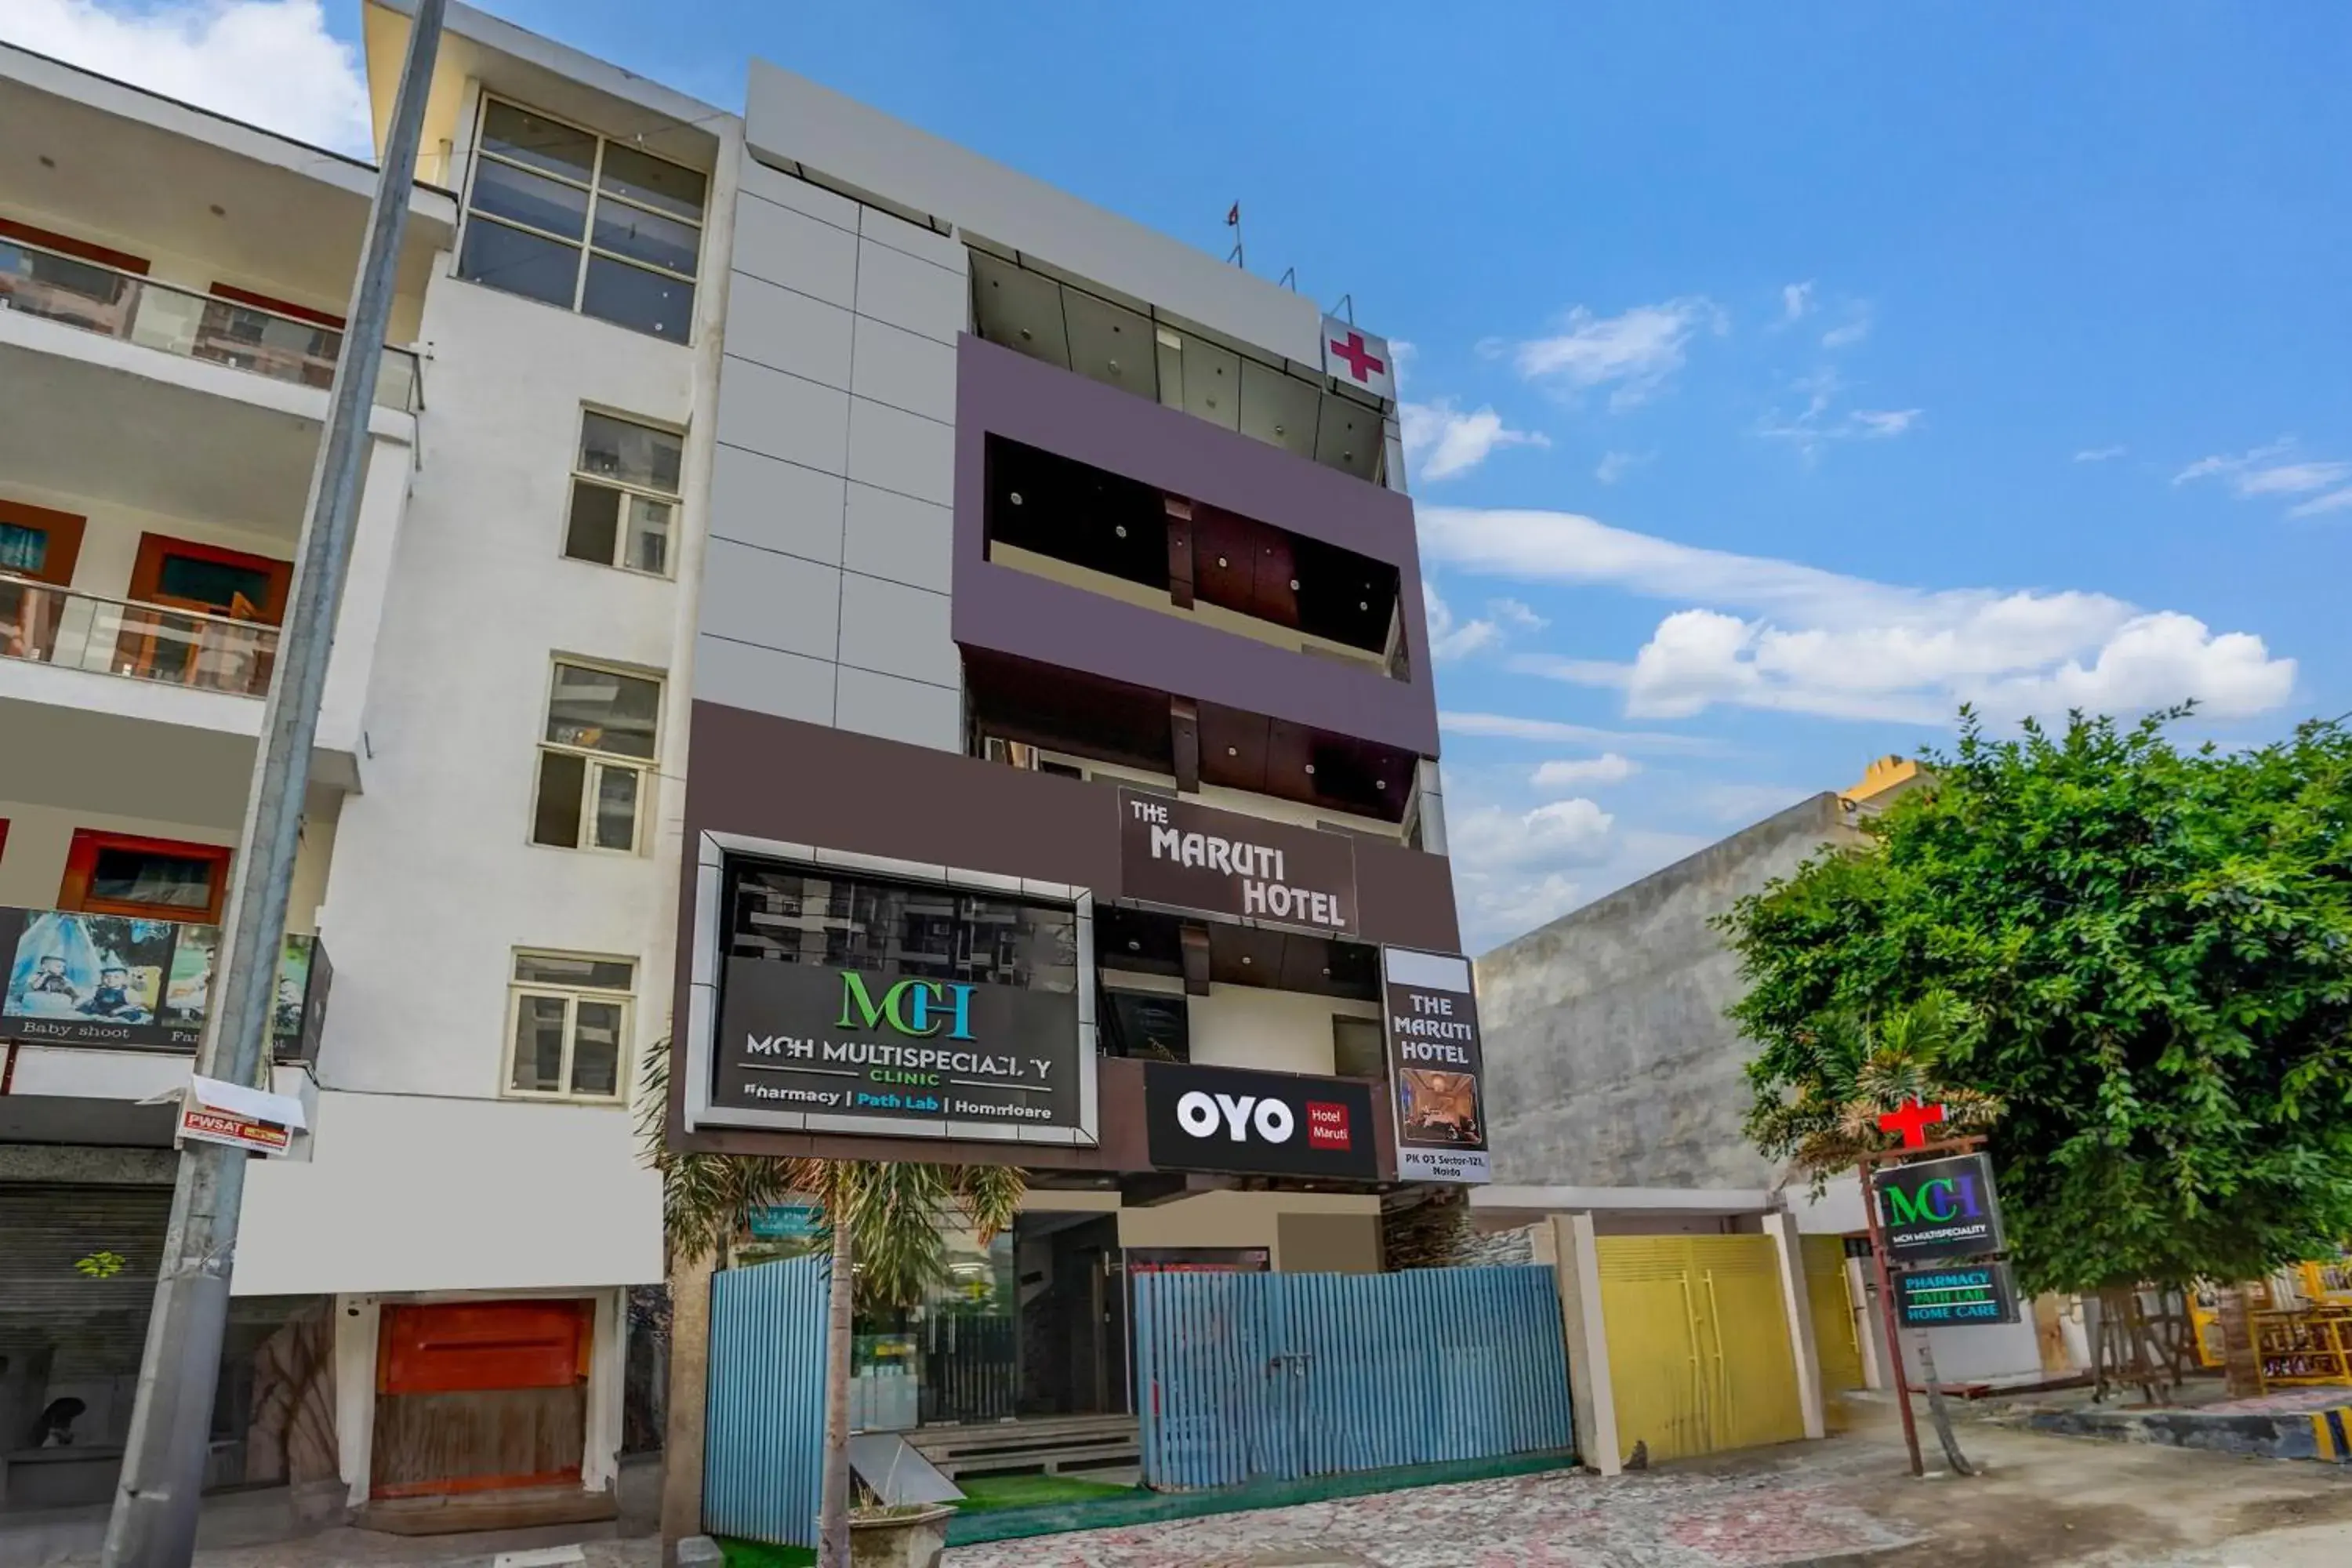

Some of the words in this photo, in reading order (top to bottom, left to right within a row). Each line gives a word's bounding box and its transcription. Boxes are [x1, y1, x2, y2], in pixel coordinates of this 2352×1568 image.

[1131, 800, 1169, 824] THE
[1151, 824, 1284, 881] MARUTI
[1243, 879, 1345, 927] HOTEL
[834, 971, 978, 1041] MCH
[1410, 993, 1454, 1016] THE
[21, 1021, 73, 1037] Baby
[78, 1024, 131, 1039] shoot
[1393, 1015, 1472, 1040] MARUTI
[823, 1040, 1052, 1080] MULTISPECIAIY
[1401, 1040, 1468, 1064] HOTEL
[869, 1069, 940, 1087] CLINIC
[858, 1092, 901, 1108] Path
[906, 1095, 939, 1111] Lab
[187, 1113, 243, 1134] PWSAT
[1177, 1091, 1294, 1143] OYO
[1312, 1109, 1341, 1122] Hotel
[1313, 1126, 1348, 1140] Maruti
[1886, 1174, 1984, 1227] MCH
[1905, 1271, 1989, 1289] PHARMACY
[1907, 1306, 1951, 1321] HOME
[1955, 1303, 1998, 1318] CARE
